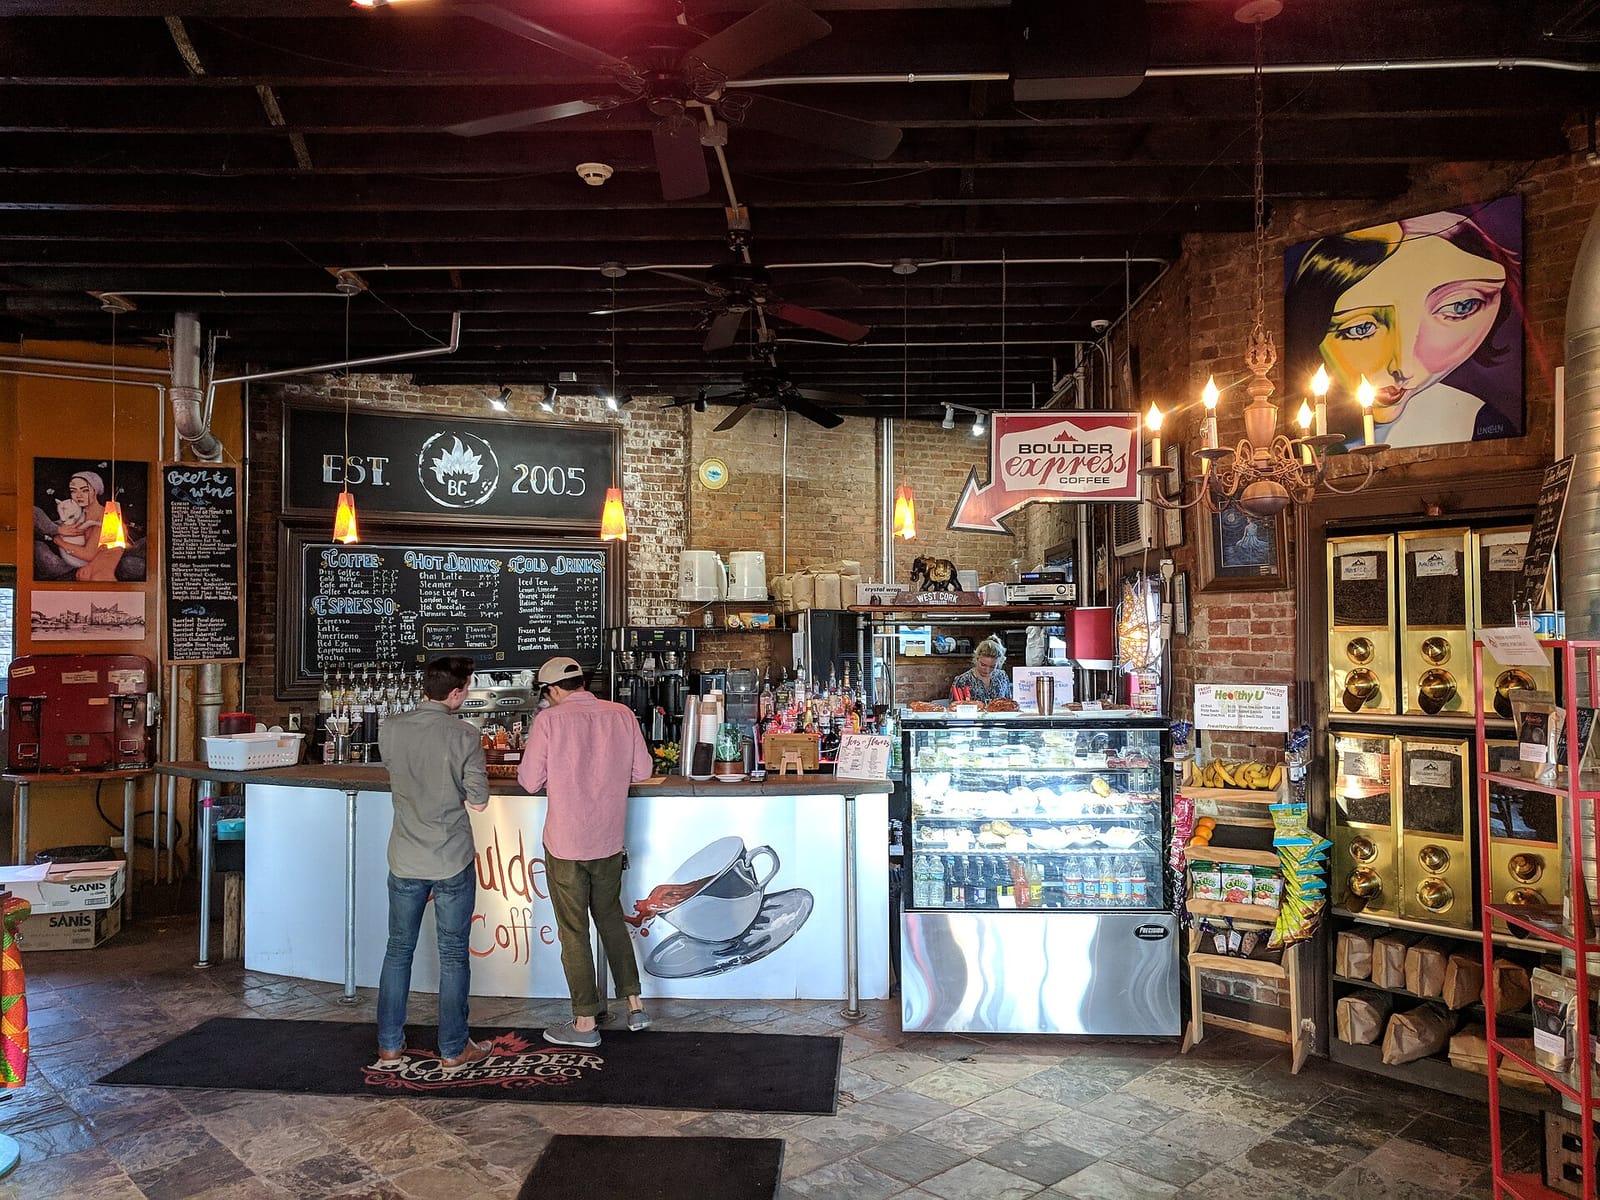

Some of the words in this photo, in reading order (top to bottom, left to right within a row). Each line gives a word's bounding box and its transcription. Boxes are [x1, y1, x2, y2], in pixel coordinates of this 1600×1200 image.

[1018, 444, 1113, 454] BOULDER
[322, 454, 391, 486] EST.
[511, 463, 587, 496] 2005
[1005, 453, 1127, 485] express
[1059, 476, 1110, 484] COFFEE
[189, 482, 235, 498] wine
[447, 480, 468, 497] BC
[321, 548, 379, 568] COFFEE
[404, 551, 444, 570] HOT
[444, 552, 500, 574] DRINKS
[508, 555, 548, 574] COLD
[550, 556, 602, 576] DRINKS
[338, 568, 360, 578] Coffee
[419, 572, 437, 580] Chai
[441, 572, 463, 580] Latte
[420, 580, 452, 588] Steamer
[535, 577, 549, 586] Tea
[420, 588, 440, 596] Loose
[460, 589, 476, 598] Tea
[916, 592, 937, 604] WEST
[940, 592, 958, 604] CORK
[312, 596, 394, 616] ESPRESSO
[317, 617, 350, 627] Espresso
[317, 624, 340, 632] Latte
[400, 622, 416, 631] Hot
[317, 632, 359, 640] Americano
[334, 640, 349, 648] Eye
[318, 648, 361, 656] Cappuccino
[1214, 690, 1254, 702] Healthy
[1254, 690, 1264, 700] U
[475, 824, 549, 904] ulde
[468, 906, 561, 965] Coffe
[367, 1052, 606, 1076] BOLDER
[400, 1064, 530, 1083] COFFEE
